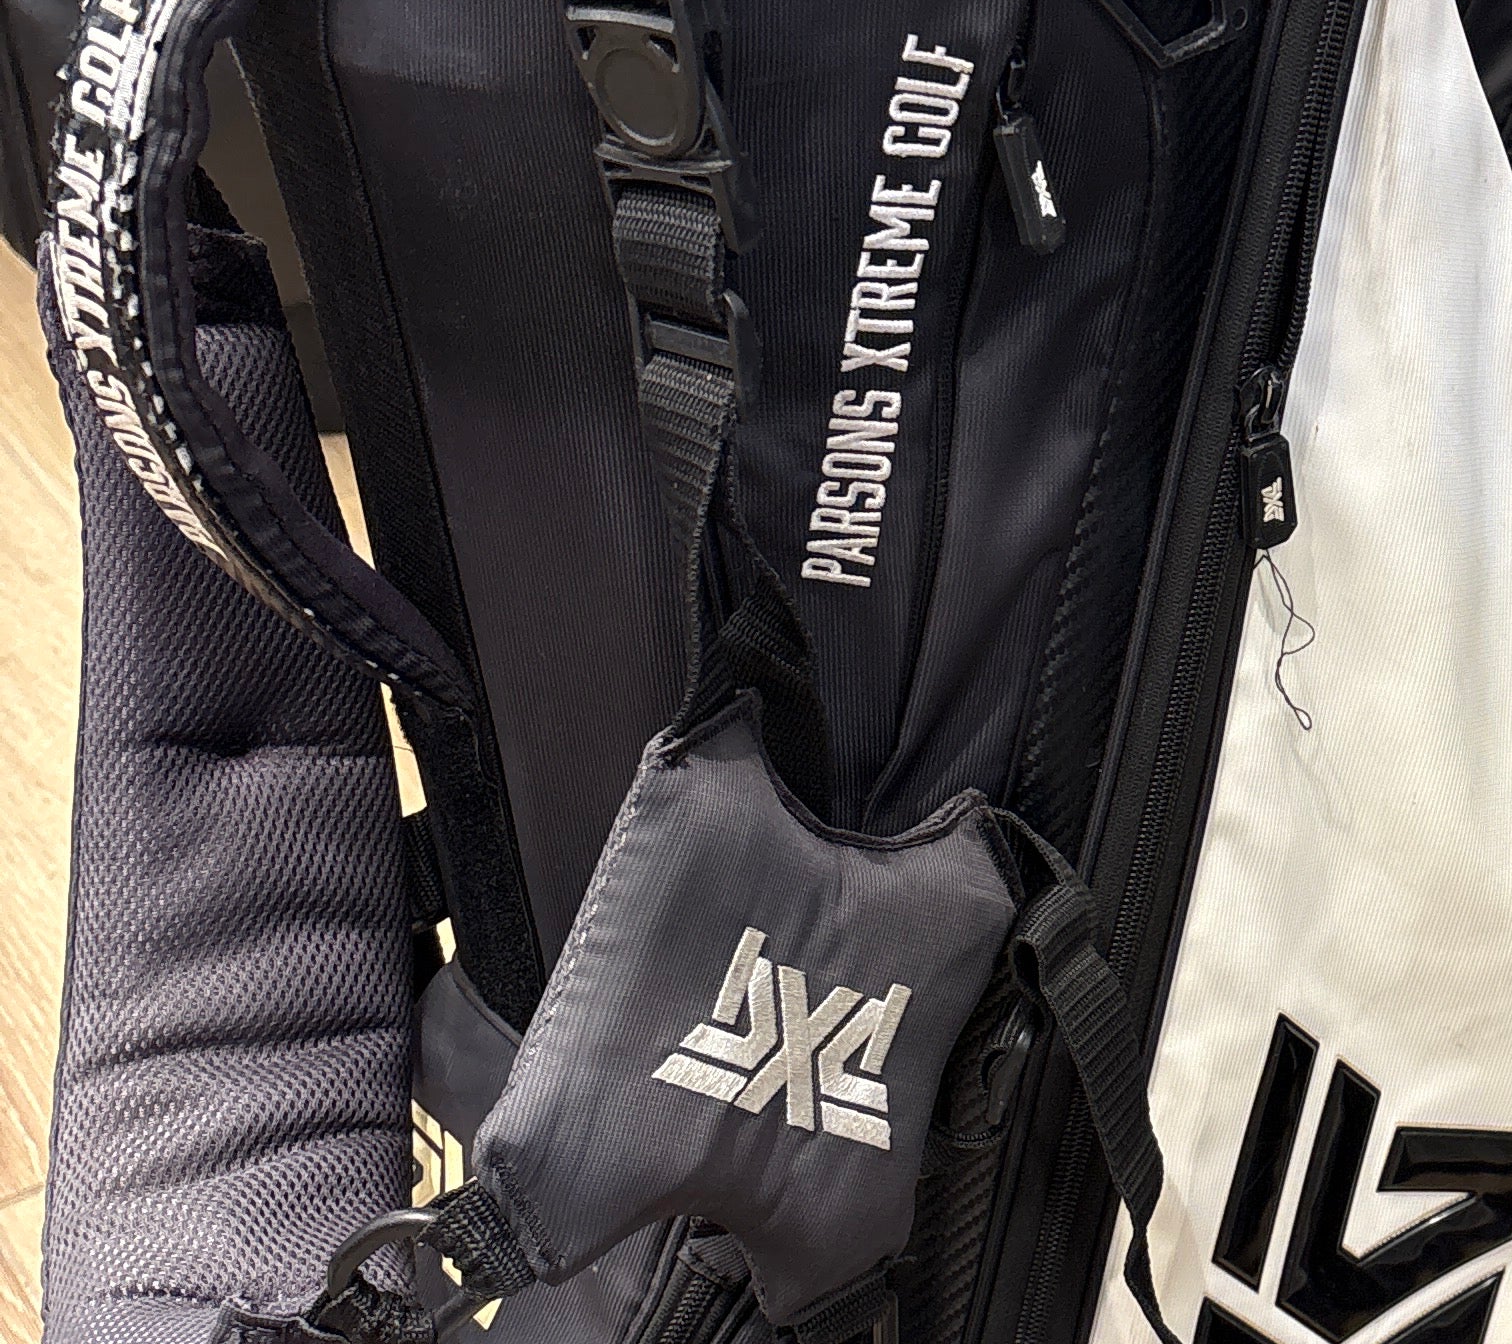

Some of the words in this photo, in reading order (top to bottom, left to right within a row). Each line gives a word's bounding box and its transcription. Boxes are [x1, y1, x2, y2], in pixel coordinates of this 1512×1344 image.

[882, 33, 975, 158] GOLF
[840, 174, 942, 372] XTREME
[800, 389, 902, 587] PARSONS
[651, 926, 912, 1151] PXG
